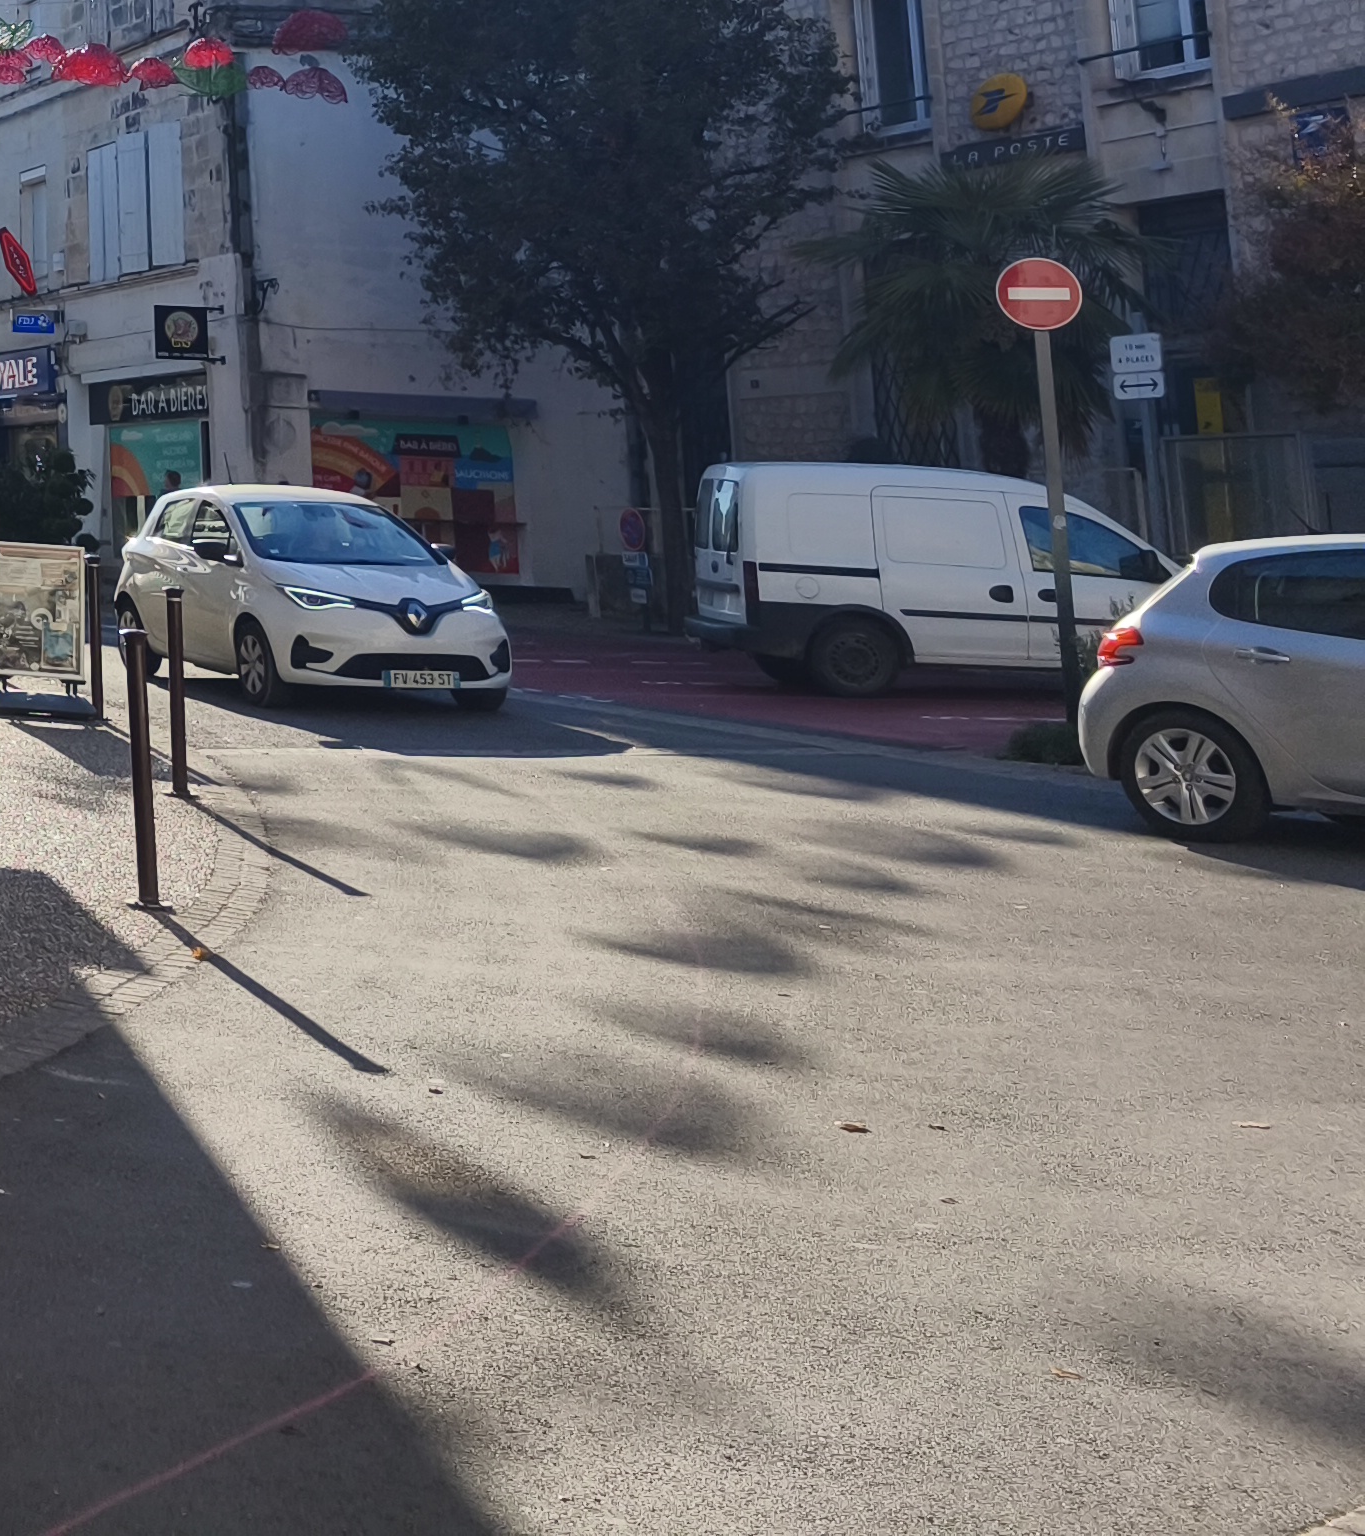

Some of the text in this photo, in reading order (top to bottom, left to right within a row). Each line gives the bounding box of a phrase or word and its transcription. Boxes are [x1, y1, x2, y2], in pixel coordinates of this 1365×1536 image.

[994, 133, 1070, 158] POSTE
[18, 316, 35, 326] FDJ
[131, 381, 208, 416] BAR À BIÈRES
